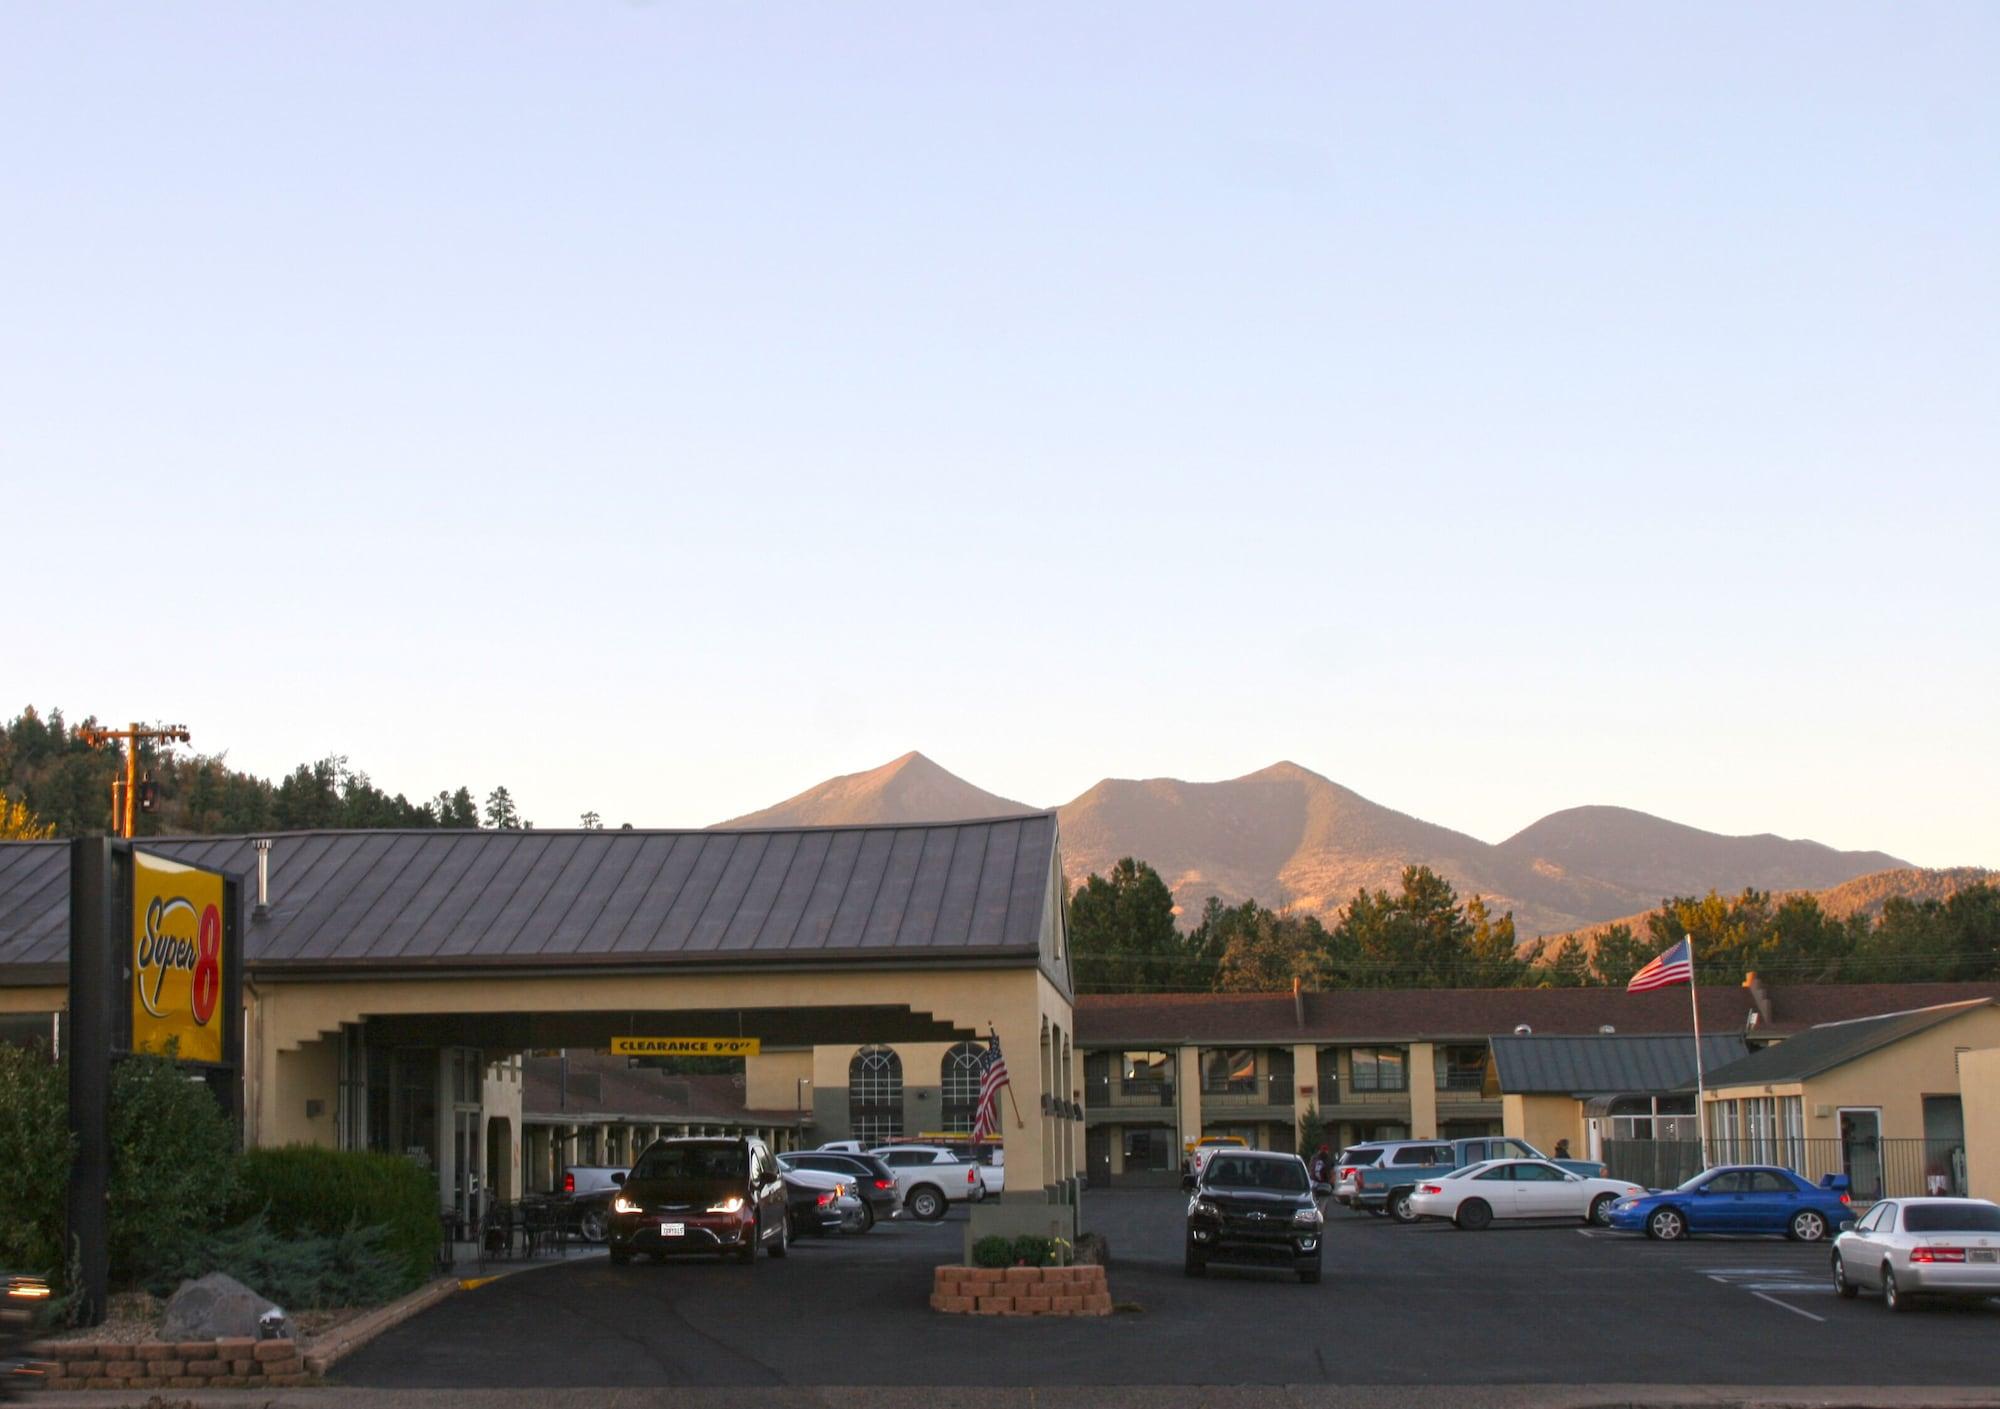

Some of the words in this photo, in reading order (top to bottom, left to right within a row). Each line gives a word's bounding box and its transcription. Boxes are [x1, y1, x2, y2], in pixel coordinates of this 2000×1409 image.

[138, 895, 197, 1008] Super
[191, 902, 222, 1026] 8
[619, 1041, 709, 1052] CLEARANCE
